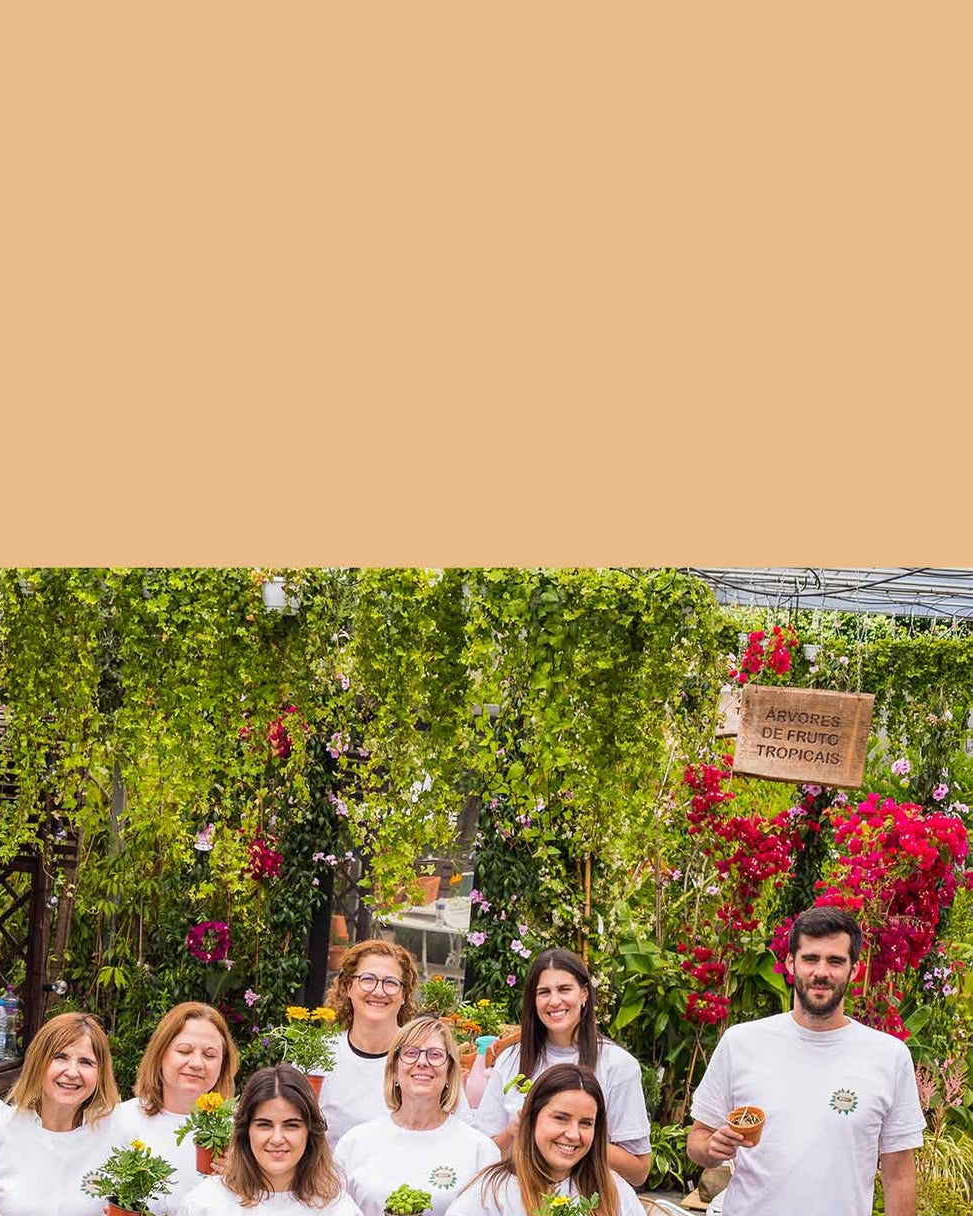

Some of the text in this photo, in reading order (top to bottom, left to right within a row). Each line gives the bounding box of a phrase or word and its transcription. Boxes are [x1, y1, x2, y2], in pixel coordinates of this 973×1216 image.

[765, 706, 841, 728] ÁRVORES
[762, 726, 839, 746] DE FRUTO
[756, 744, 841, 765] TROPICAIS
